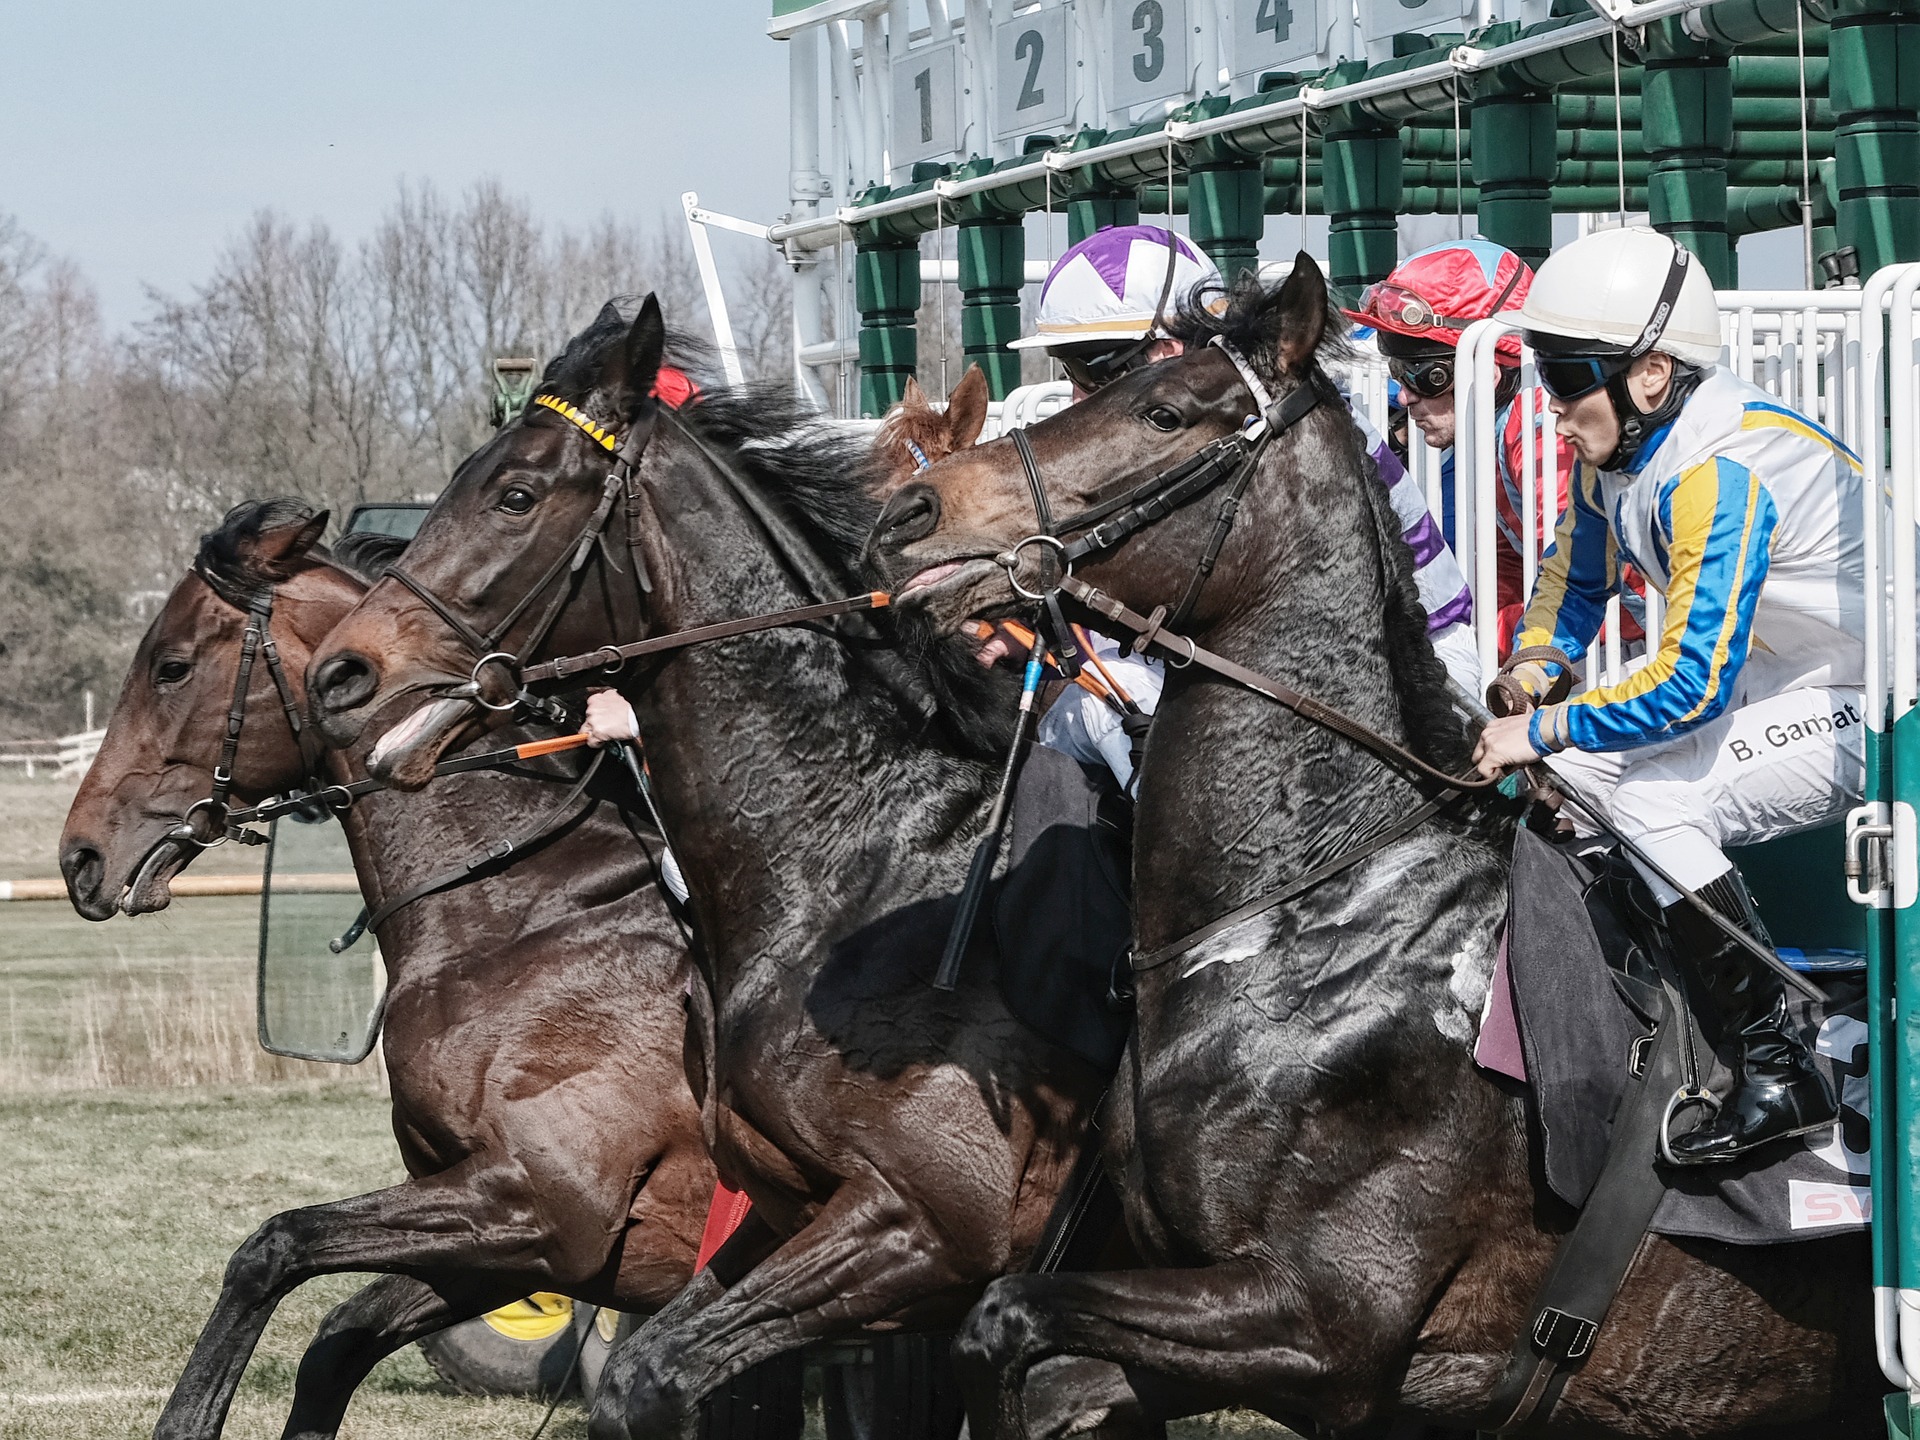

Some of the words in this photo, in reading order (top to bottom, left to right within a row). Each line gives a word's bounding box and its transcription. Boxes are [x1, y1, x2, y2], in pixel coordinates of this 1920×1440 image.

[1132, 0, 1165, 83] 3
[1256, 0, 1294, 44] 4
[914, 67, 933, 144] 1
[1015, 29, 1045, 111] 2
[1728, 739, 1763, 763] B.
